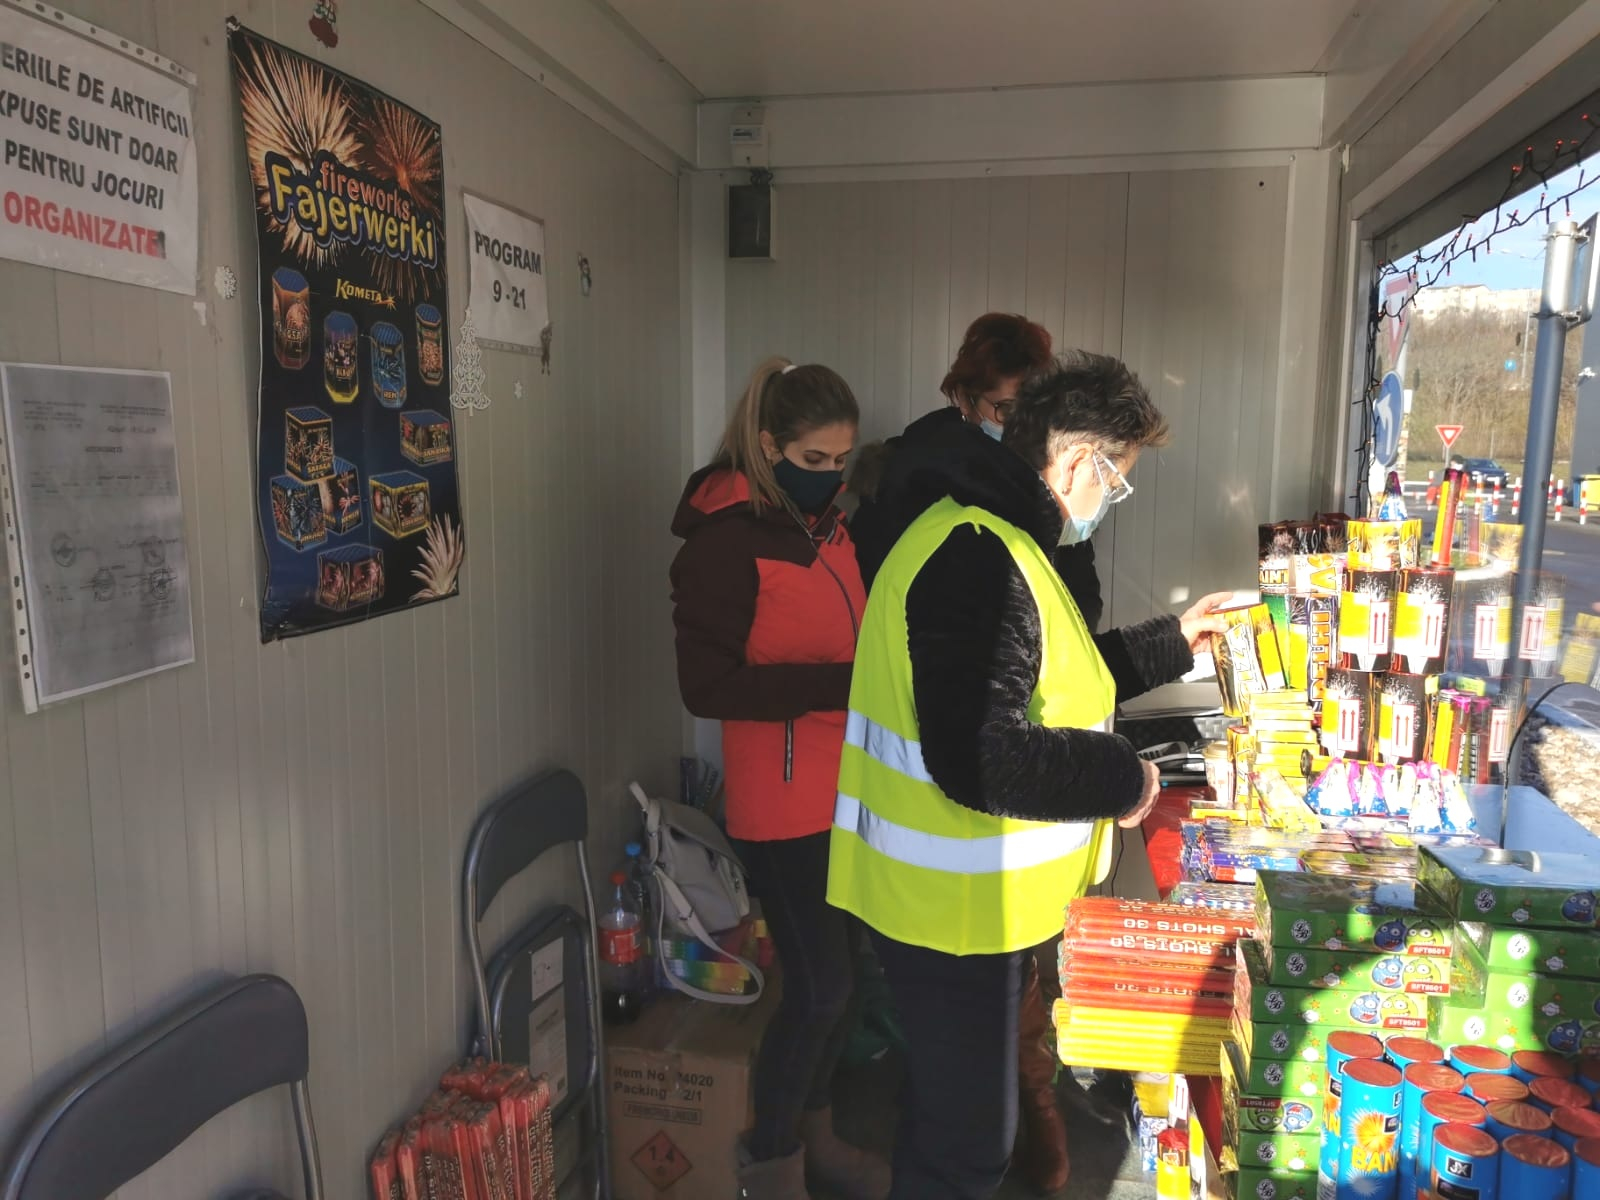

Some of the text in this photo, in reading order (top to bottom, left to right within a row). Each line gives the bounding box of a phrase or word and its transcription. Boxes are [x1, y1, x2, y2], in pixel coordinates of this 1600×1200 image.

[77, 71, 105, 105] DE
[110, 86, 189, 138] ARTIFICII
[67, 115, 123, 154] SUNT
[129, 137, 178, 174] DOAR
[5, 139, 164, 210] PENTRU JOCURI
[320, 160, 411, 221] fireworks
[271, 164, 435, 260] Fajerwerki
[474, 230, 542, 275] PROGRAM
[335, 278, 383, 303] KOMETA
[493, 279, 502, 303] 9
[512, 286, 526, 310] 21
[1123, 918, 1149, 929] 30
[1156, 920, 1226, 935] SHOTS
[1143, 939, 1212, 955] SHOTS
[614, 1066, 643, 1079] Item
[614, 1081, 668, 1100] Packing
